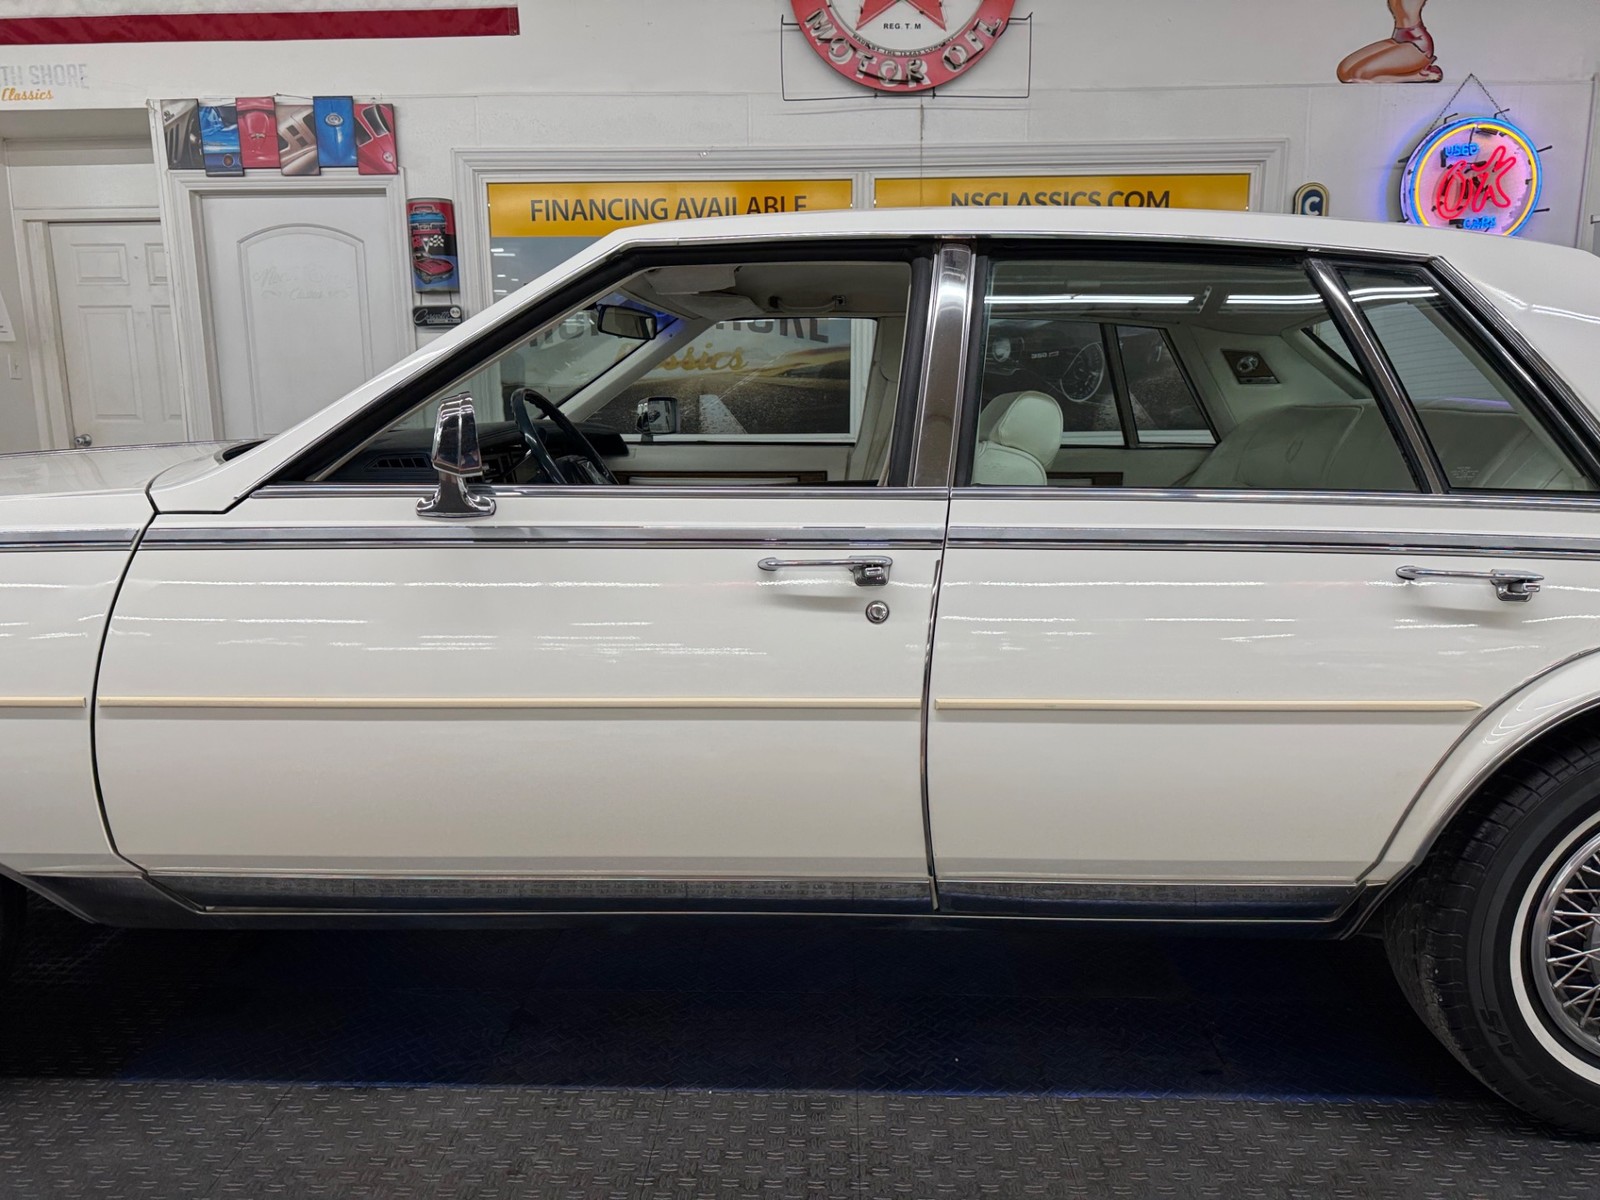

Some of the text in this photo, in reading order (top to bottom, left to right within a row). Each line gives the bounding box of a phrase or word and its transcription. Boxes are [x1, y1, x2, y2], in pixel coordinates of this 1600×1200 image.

[804, 8, 1003, 88] MOTOR OIL
[0, 63, 90, 90] TH SHORE
[1, 86, 54, 102] Classics
[1444, 142, 1480, 157] USED
[529, 194, 808, 222] FINANCING AVAILABLE
[950, 190, 1171, 209] NSCLASSICSCOM
[1463, 216, 1497, 230] CARS
